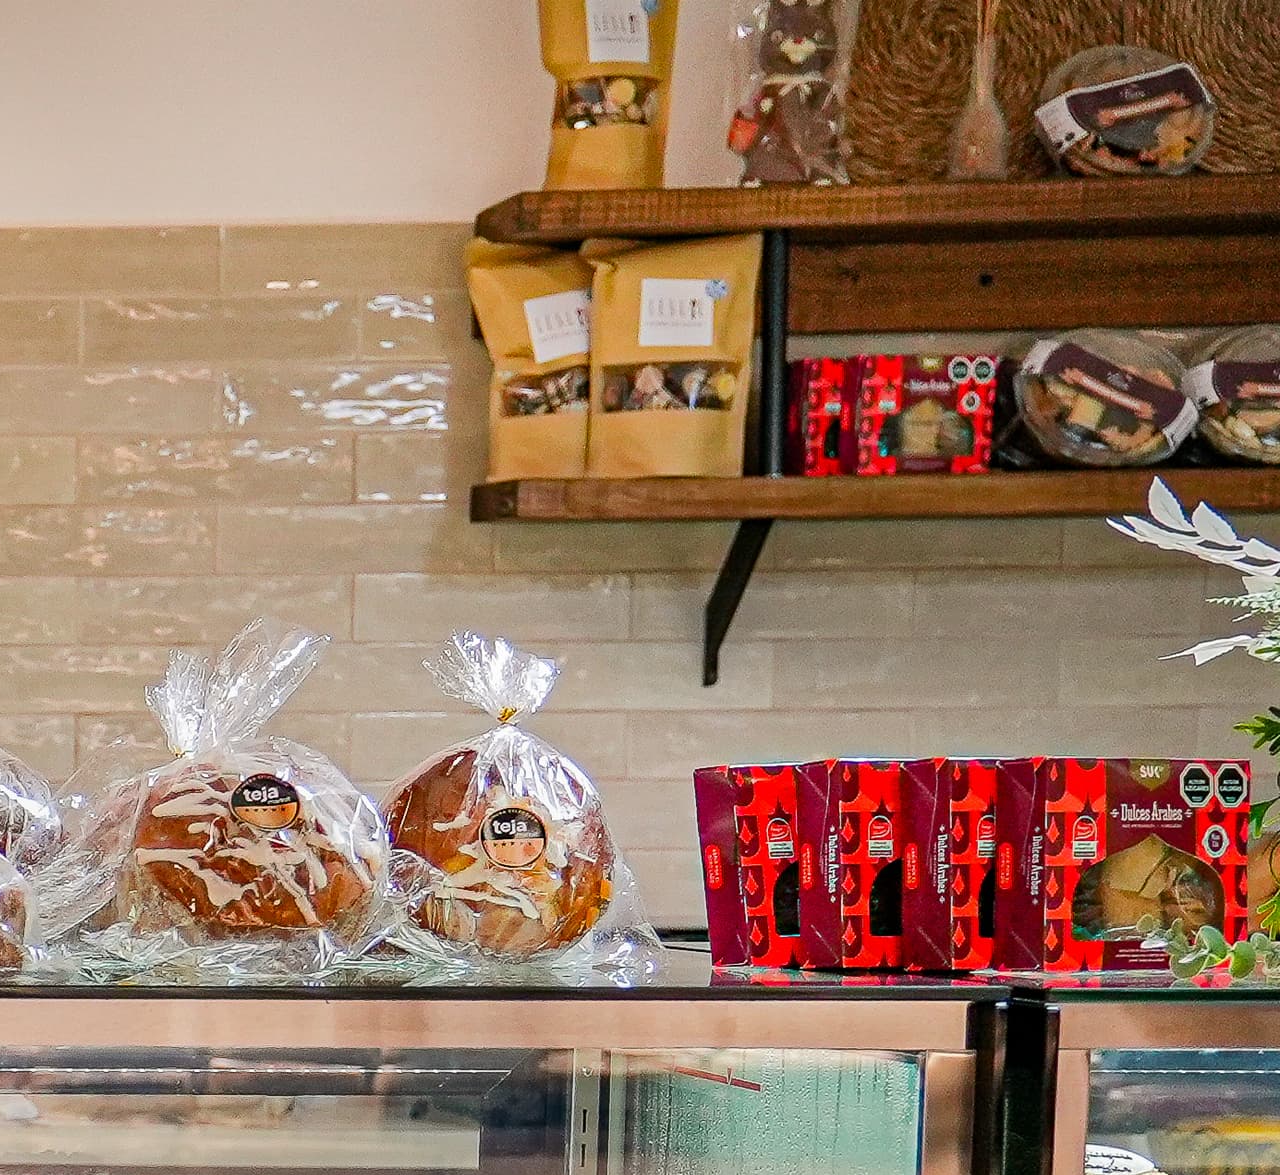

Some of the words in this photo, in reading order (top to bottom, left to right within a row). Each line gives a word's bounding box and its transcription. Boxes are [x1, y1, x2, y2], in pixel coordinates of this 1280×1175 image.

[243, 786, 280, 803] teja
[1121, 803, 1151, 821] Dulces
[492, 819, 528, 835] teja
